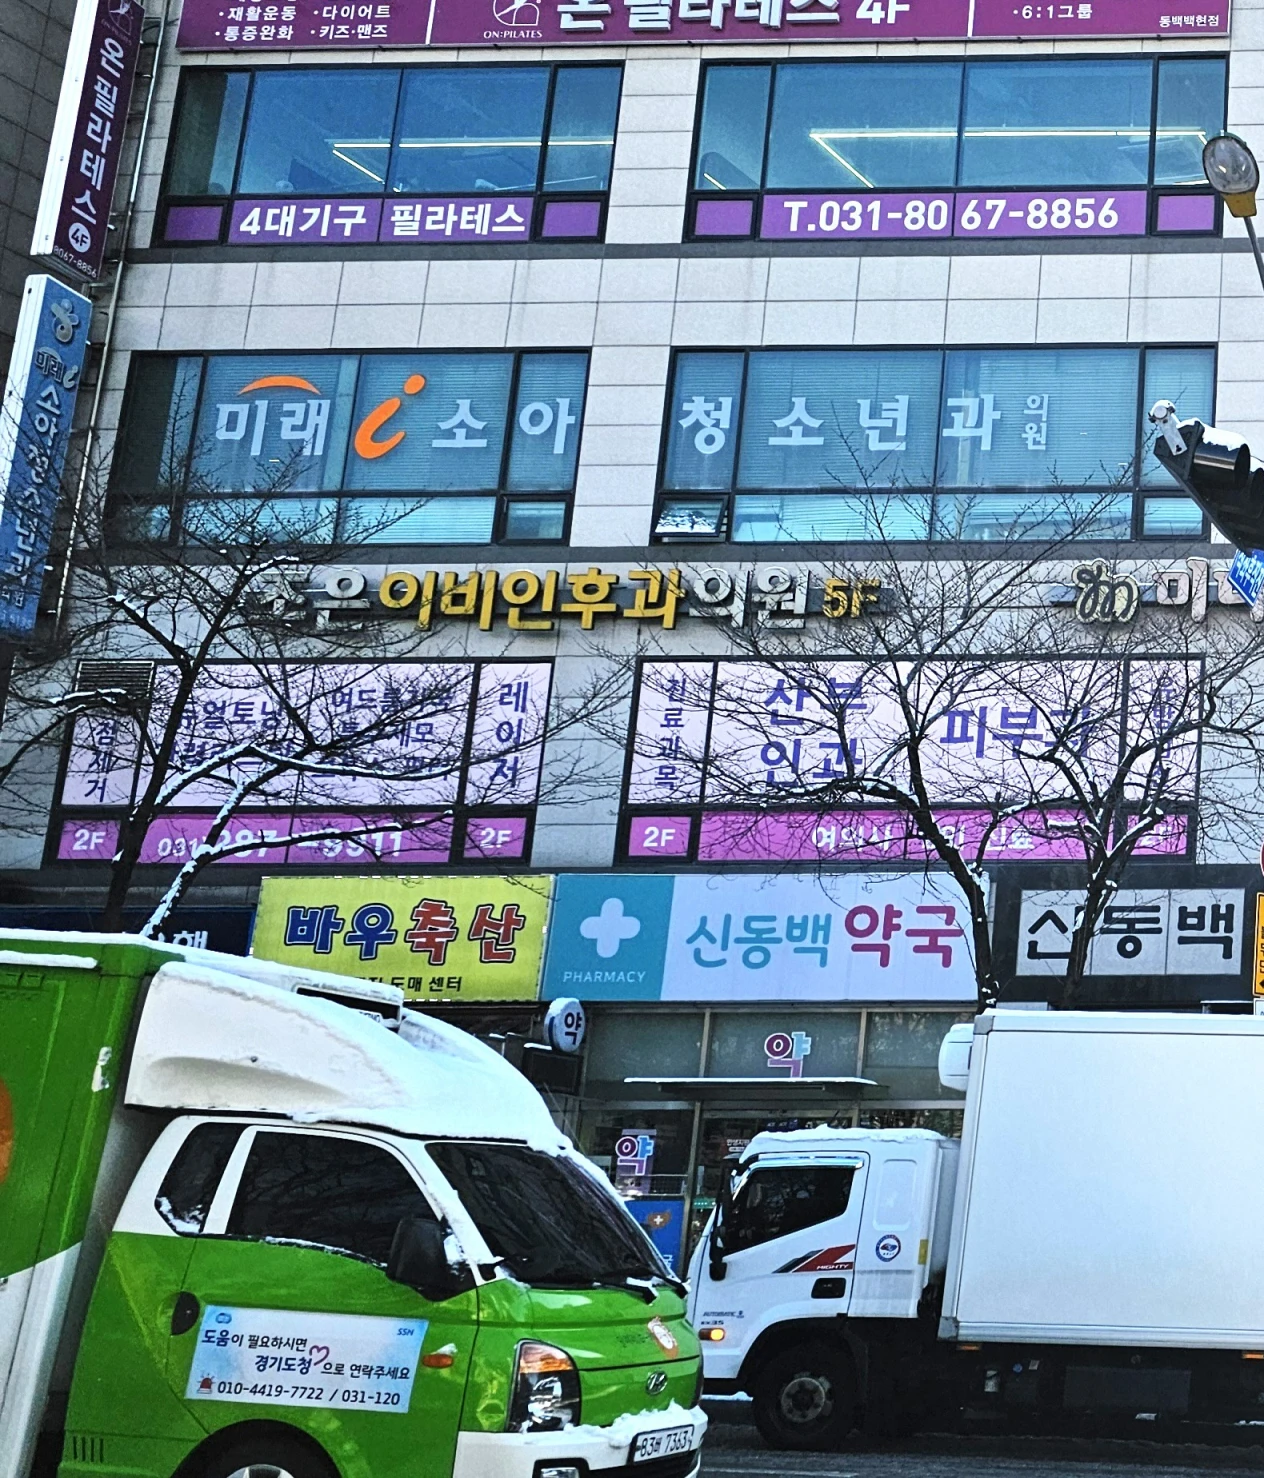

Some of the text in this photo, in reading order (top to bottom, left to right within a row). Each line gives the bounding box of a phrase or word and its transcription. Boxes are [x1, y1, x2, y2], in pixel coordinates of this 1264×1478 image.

[228, 4, 391, 21] 재활운동 다이어트
[1159, 14, 1220, 28] 동백백현점
[224, 24, 293, 41] 통증완화
[240, 202, 526, 238] 4대기구 필라테스
[70, 226, 89, 248] 4F
[215, 399, 331, 457] 미래
[432, 396, 576, 455] 소아
[72, 828, 106, 851] 2F
[478, 827, 512, 849] 2F
[643, 825, 676, 847] 2F
[686, 903, 965, 970] 신동백 약국
[1027, 903, 1236, 962] 신동백
[429, 976, 463, 992] 센터
[562, 970, 647, 984] PHARMACY
[563, 1011, 583, 1046] 약
[764, 1030, 811, 1078] 약
[614, 1134, 654, 1176] 약
[201, 1329, 308, 1351] 도움이 필요하시면
[254, 1355, 410, 1380] 경기도청 으로 연락주세요
[217, 1380, 324, 1401] 010-4419-7722
[341, 1389, 401, 1405] 031-120
